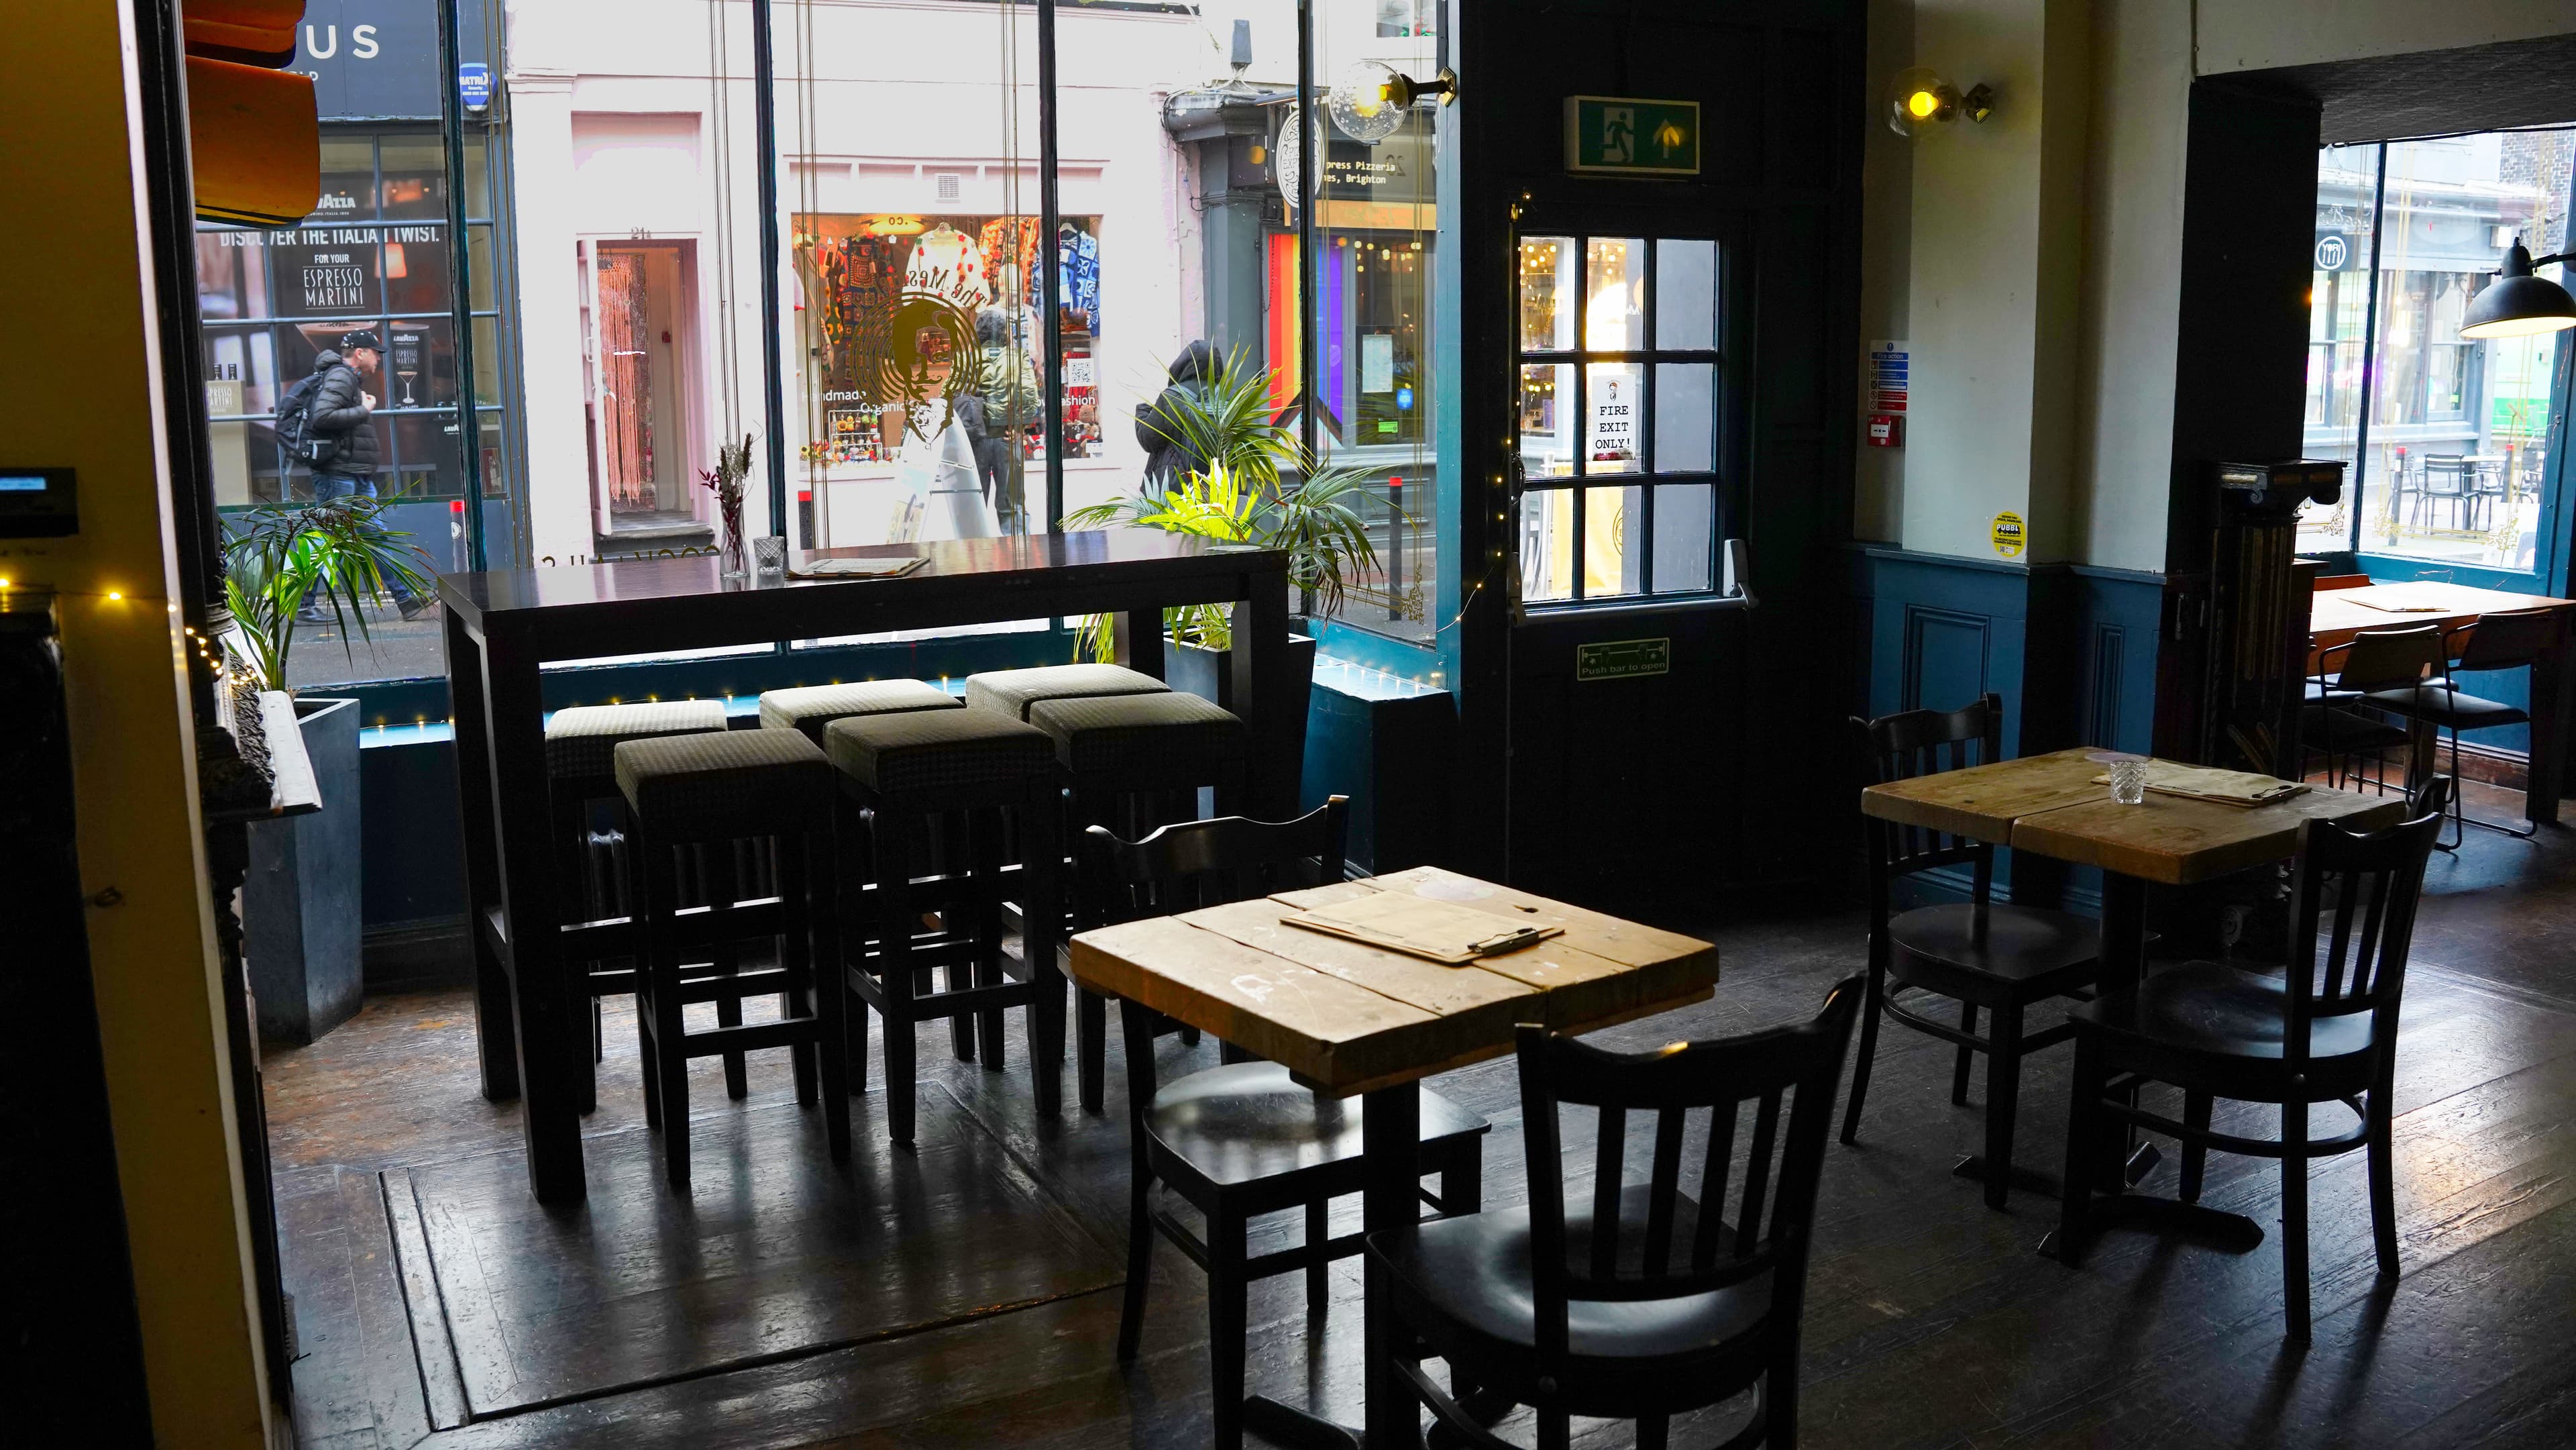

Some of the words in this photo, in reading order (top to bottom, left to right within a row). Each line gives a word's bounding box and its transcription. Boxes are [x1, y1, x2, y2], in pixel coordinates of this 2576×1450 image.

[1356, 162, 1395, 172] Pizzeria
[1346, 174, 1386, 185] Brighton
[314, 254, 328, 264] FOR
[331, 254, 350, 263] YOUR
[303, 268, 362, 288] ESPRESSO
[306, 287, 364, 306] MARTINI
[396, 350, 417, 358] ESPRESSO
[207, 387, 232, 397] PRESSO
[1061, 395, 1096, 406] ashion
[1599, 405, 1629, 415] FIRE
[1599, 422, 1629, 432] EXIT
[1595, 438, 1630, 449] ONLY!
[1996, 523, 2019, 532] PUBBL
[1582, 666, 1607, 675] Push
[1610, 664, 1625, 672] bar
[1641, 662, 1665, 671] open
